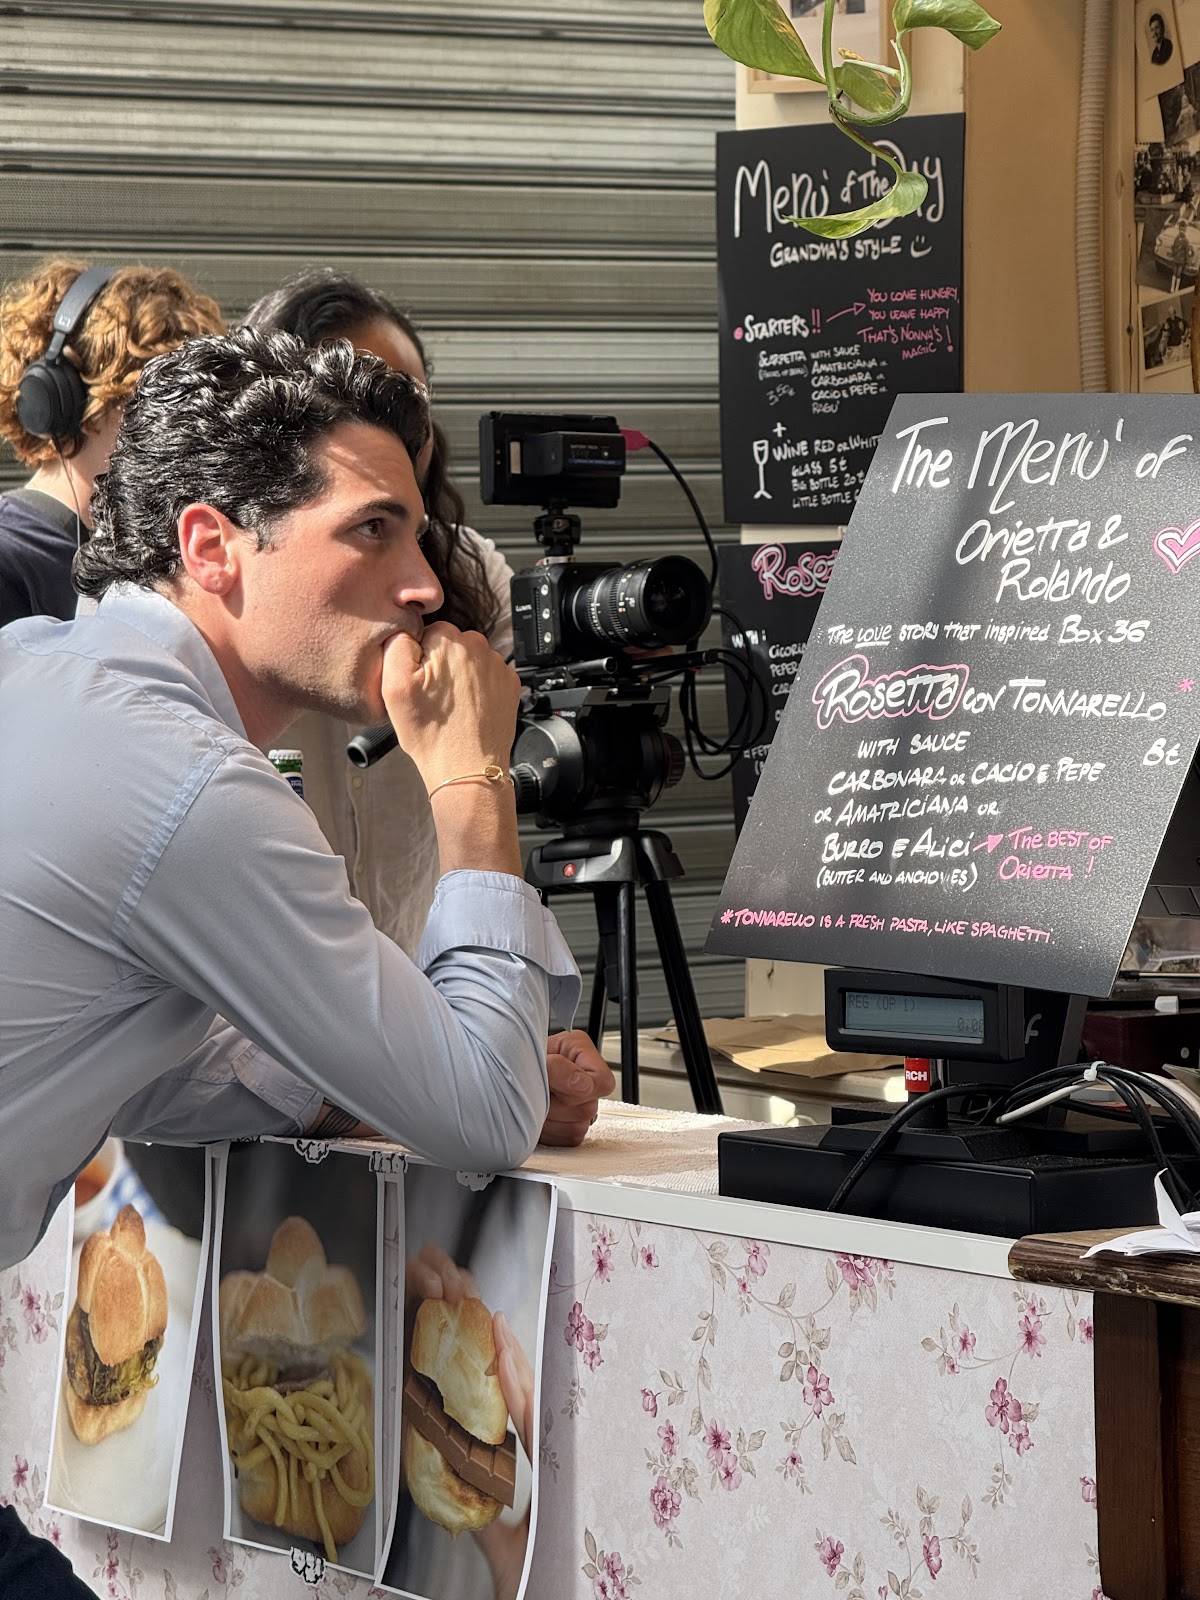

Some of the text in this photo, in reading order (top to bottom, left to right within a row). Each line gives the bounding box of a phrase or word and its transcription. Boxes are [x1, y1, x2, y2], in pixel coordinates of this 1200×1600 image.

[857, 170, 892, 199] The
[871, 139, 945, 229] Dy
[770, 235, 901, 268] GRANDMA'S STYLE
[867, 287, 887, 302] YOU
[890, 289, 916, 300] COME
[869, 307, 949, 320] YOU LEAVE HAPPY
[857, 324, 898, 344] THAT'S
[901, 323, 942, 342] NONNA'S
[833, 344, 861, 357] SAUCE
[811, 371, 872, 388] CARBONARA
[849, 382, 879, 396] PEPE
[814, 439, 835, 455] RED
[849, 434, 881, 450] WHIT
[892, 416, 952, 494] The
[792, 460, 822, 477] GLASS
[809, 476, 840, 491] BOTTLE
[792, 495, 819, 508] LITTLE
[821, 491, 852, 506] BOTTLE
[955, 514, 1129, 565] Orietta &
[996, 557, 1131, 603] Rolando
[828, 624, 854, 645] The
[899, 621, 940, 641] STORY
[985, 618, 1051, 645] inspired
[1059, 614, 1104, 644] Box
[1107, 619, 1150, 643] 36
[821, 668, 960, 719] Rosetta
[1008, 676, 1167, 721] TONNARELLO
[858, 731, 971, 758] WITH SAUCE
[827, 767, 947, 796] CARBONARA
[1055, 757, 1106, 783] PEPE
[821, 832, 884, 864] BURRO
[891, 838, 910, 858] E
[1008, 826, 1043, 850] The
[1047, 830, 1089, 848] BEST
[816, 865, 865, 888] (BUTTER
[869, 870, 892, 885] AND
[819, 915, 832, 929] IS
[835, 914, 847, 928] A
[849, 913, 886, 931] FRESH
[847, 994, 870, 1009] REG
[905, 1069, 928, 1081] RCH
